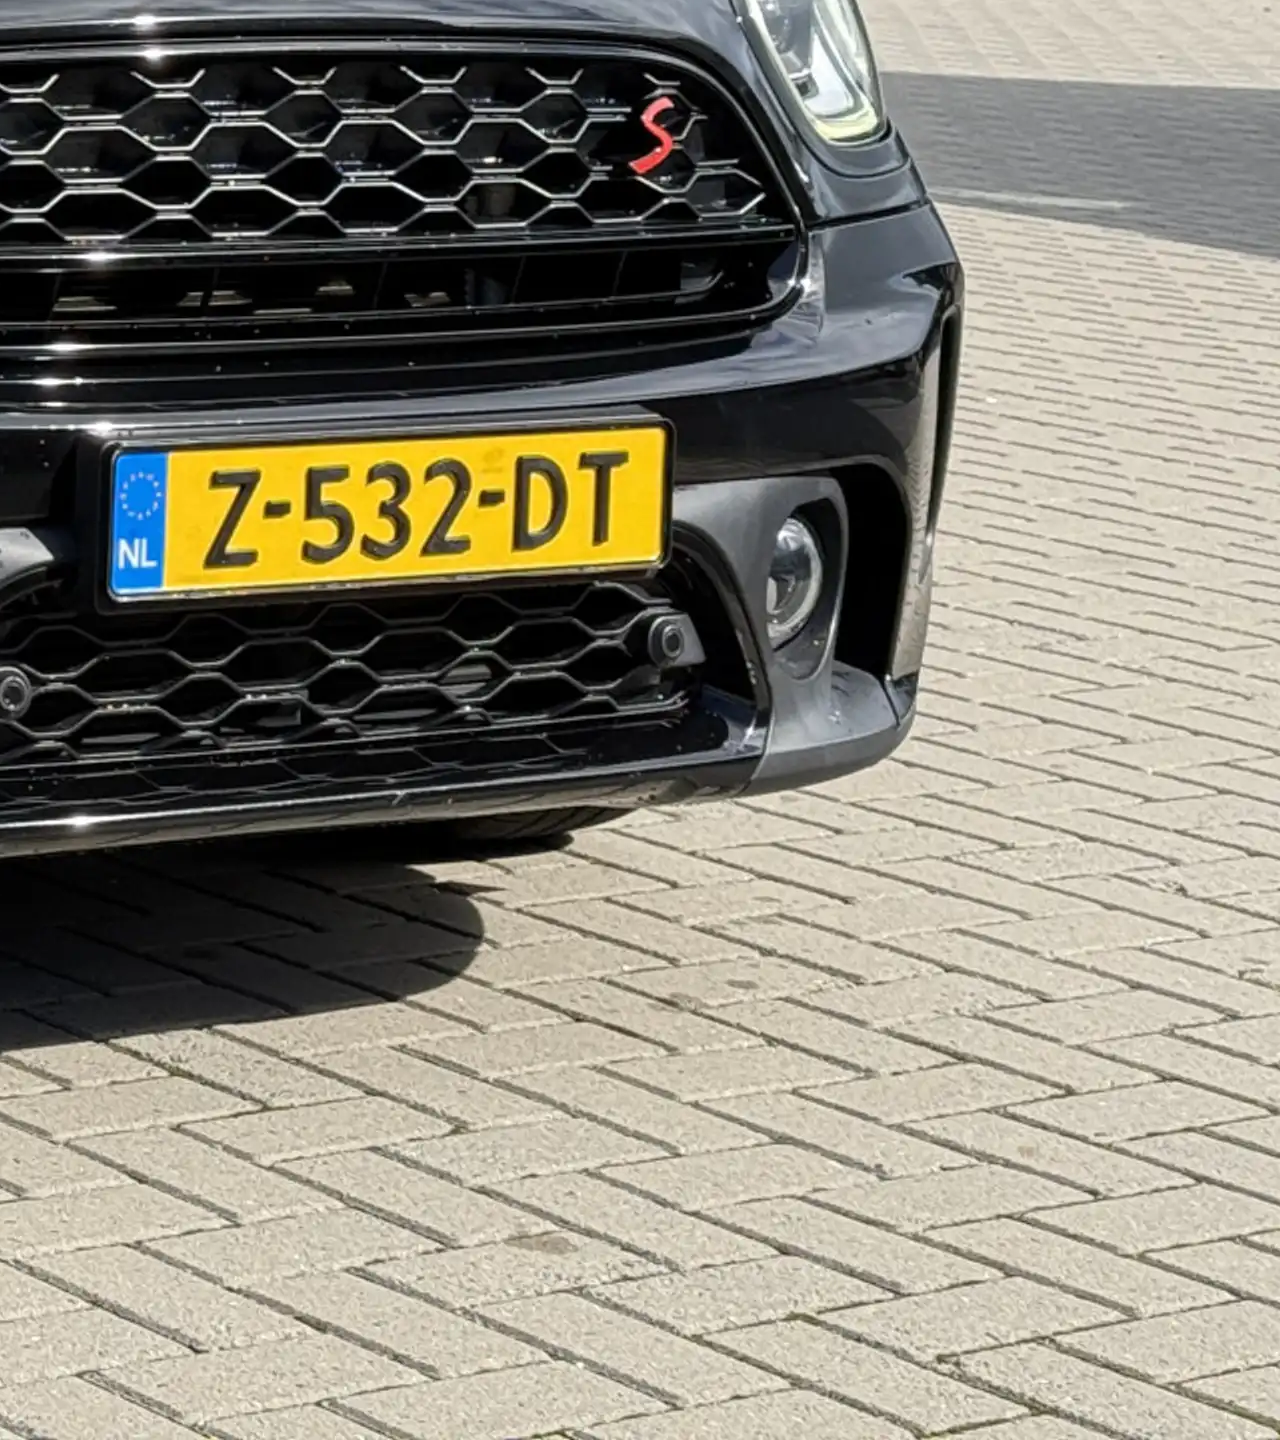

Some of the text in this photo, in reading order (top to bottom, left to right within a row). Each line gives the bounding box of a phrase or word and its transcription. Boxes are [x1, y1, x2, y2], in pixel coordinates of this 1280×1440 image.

[629, 97, 675, 173] S
[119, 452, 628, 570] NL Z-532-DT
